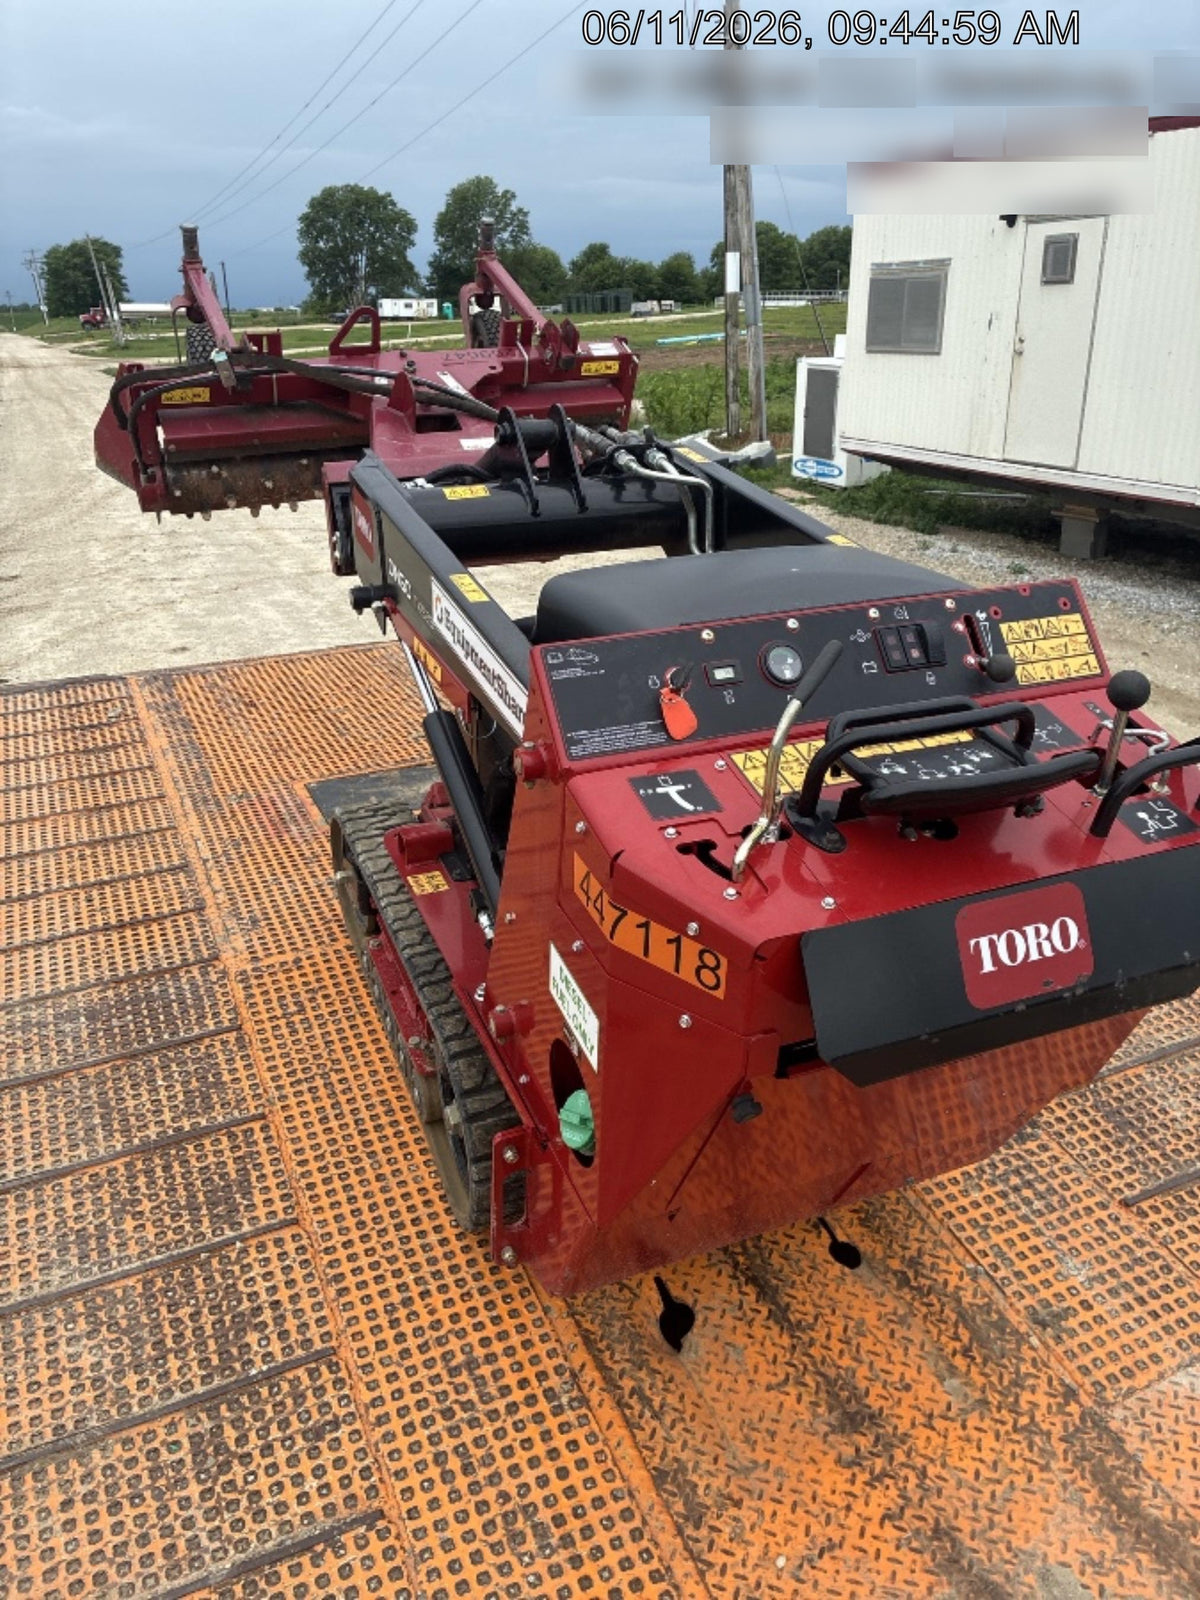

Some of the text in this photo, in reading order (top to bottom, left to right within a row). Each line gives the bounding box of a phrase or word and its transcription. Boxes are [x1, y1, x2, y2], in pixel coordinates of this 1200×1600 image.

[441, 606, 525, 723] EquipmentShar
[579, 869, 722, 991] 447118
[969, 916, 1080, 975] TORO
